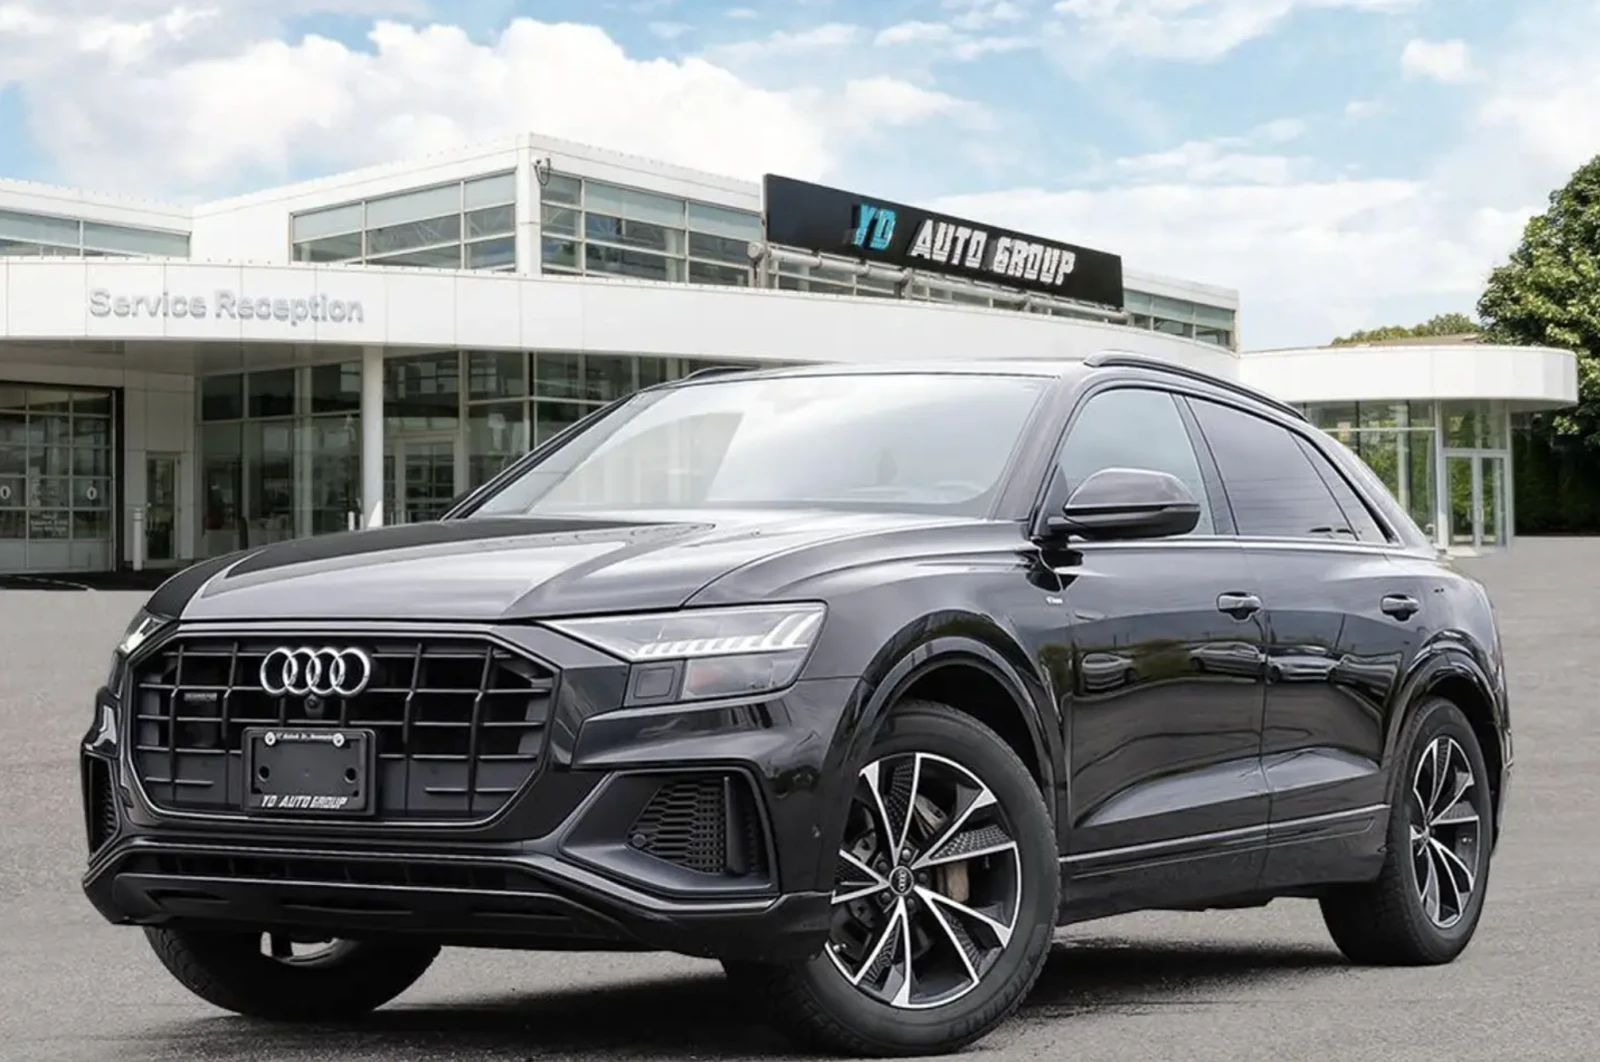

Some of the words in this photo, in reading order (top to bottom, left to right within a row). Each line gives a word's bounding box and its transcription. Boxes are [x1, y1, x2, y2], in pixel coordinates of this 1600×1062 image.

[910, 219, 987, 269] AUTO
[993, 236, 1076, 286] GROUP
[89, 289, 207, 318] Service
[214, 289, 364, 327] Reception
[278, 795, 312, 808] AUTO
[309, 795, 348, 809] GROUP
